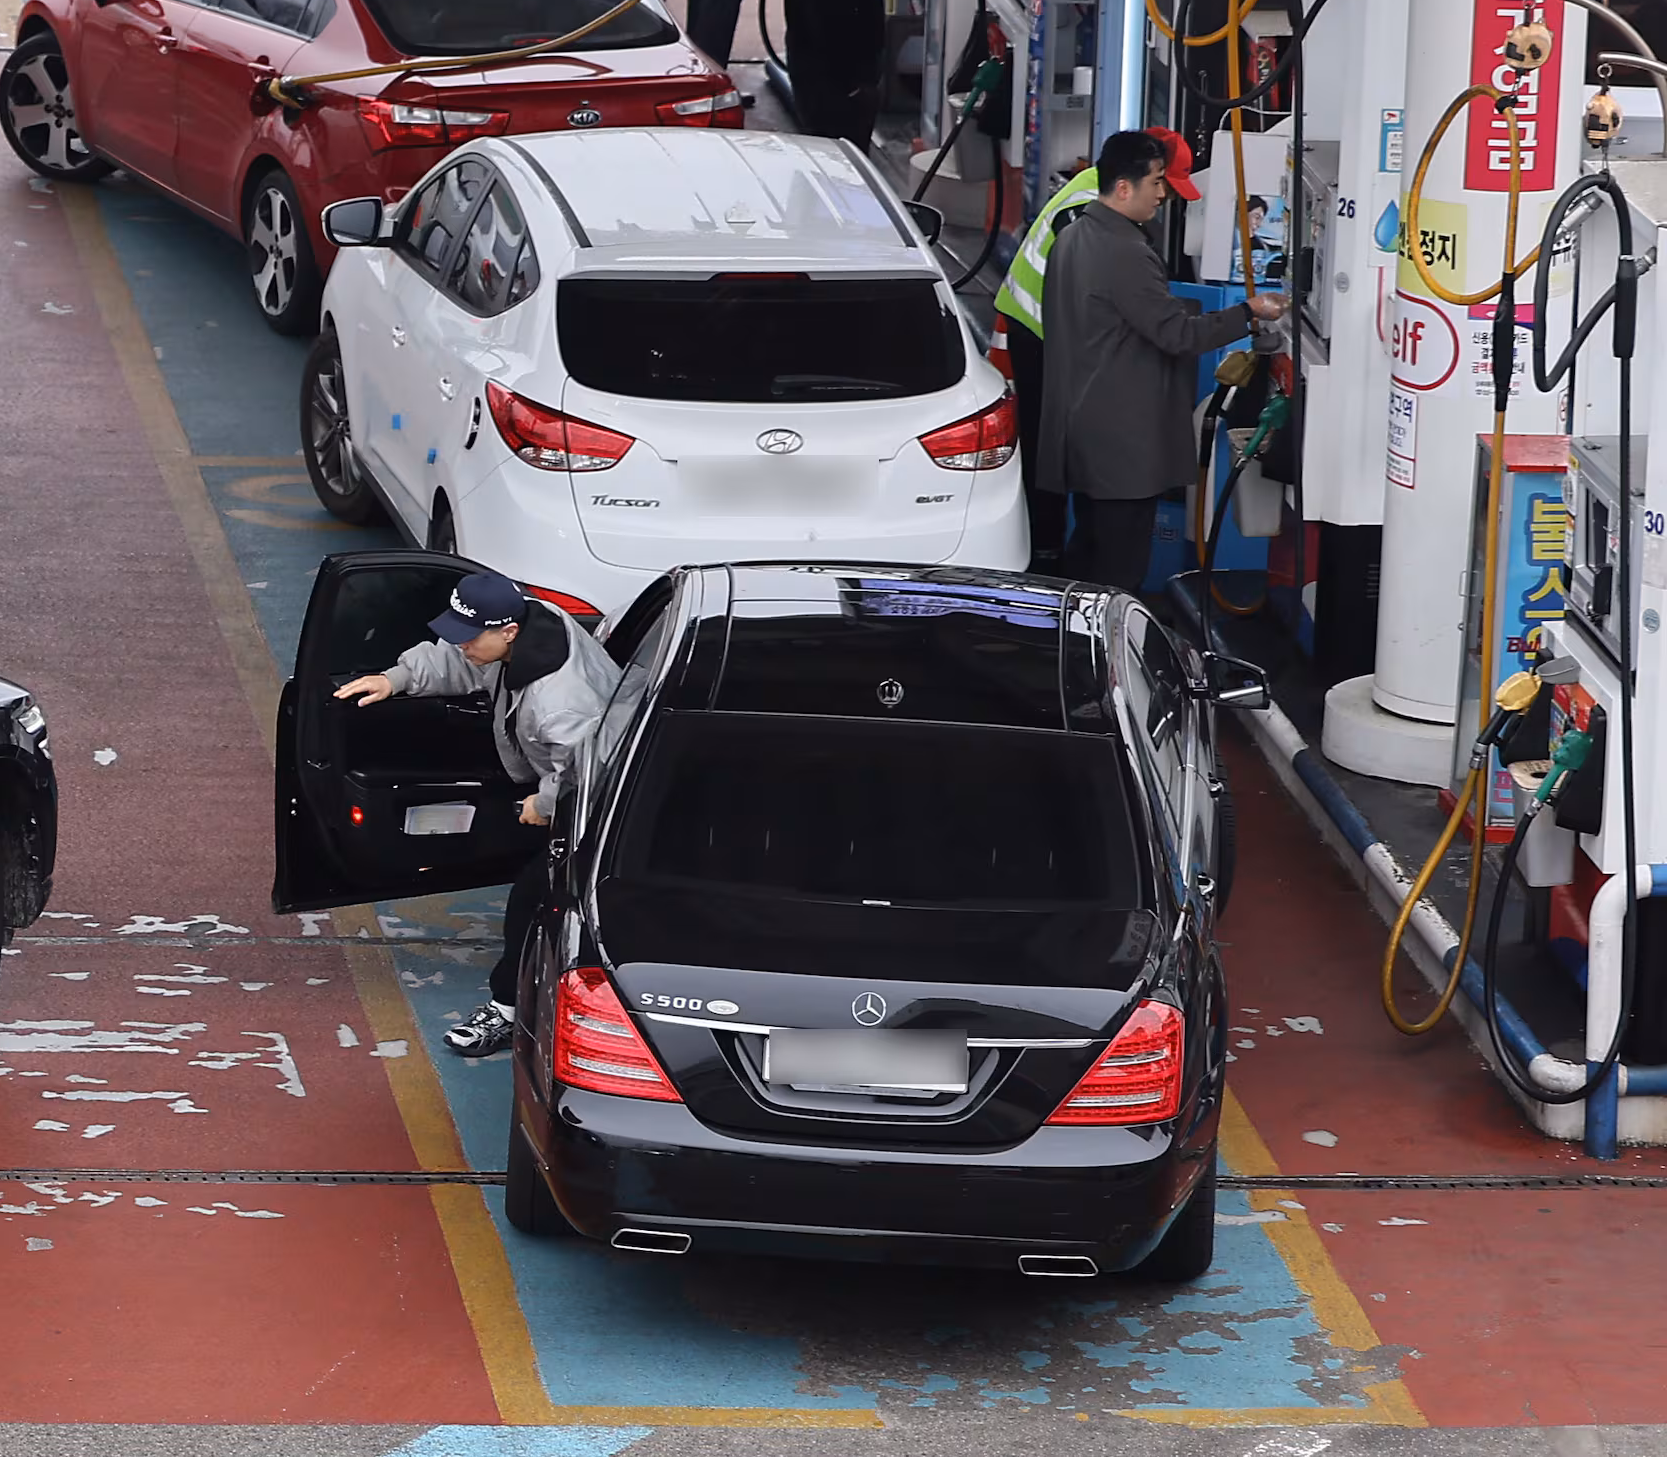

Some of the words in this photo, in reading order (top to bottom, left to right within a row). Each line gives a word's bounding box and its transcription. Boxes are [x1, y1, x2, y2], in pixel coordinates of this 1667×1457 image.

[1338, 198, 1356, 219] 26
[1399, 221, 1457, 271] 정지
[590, 494, 661, 509] Tucson
[1644, 511, 1664, 535] 30
